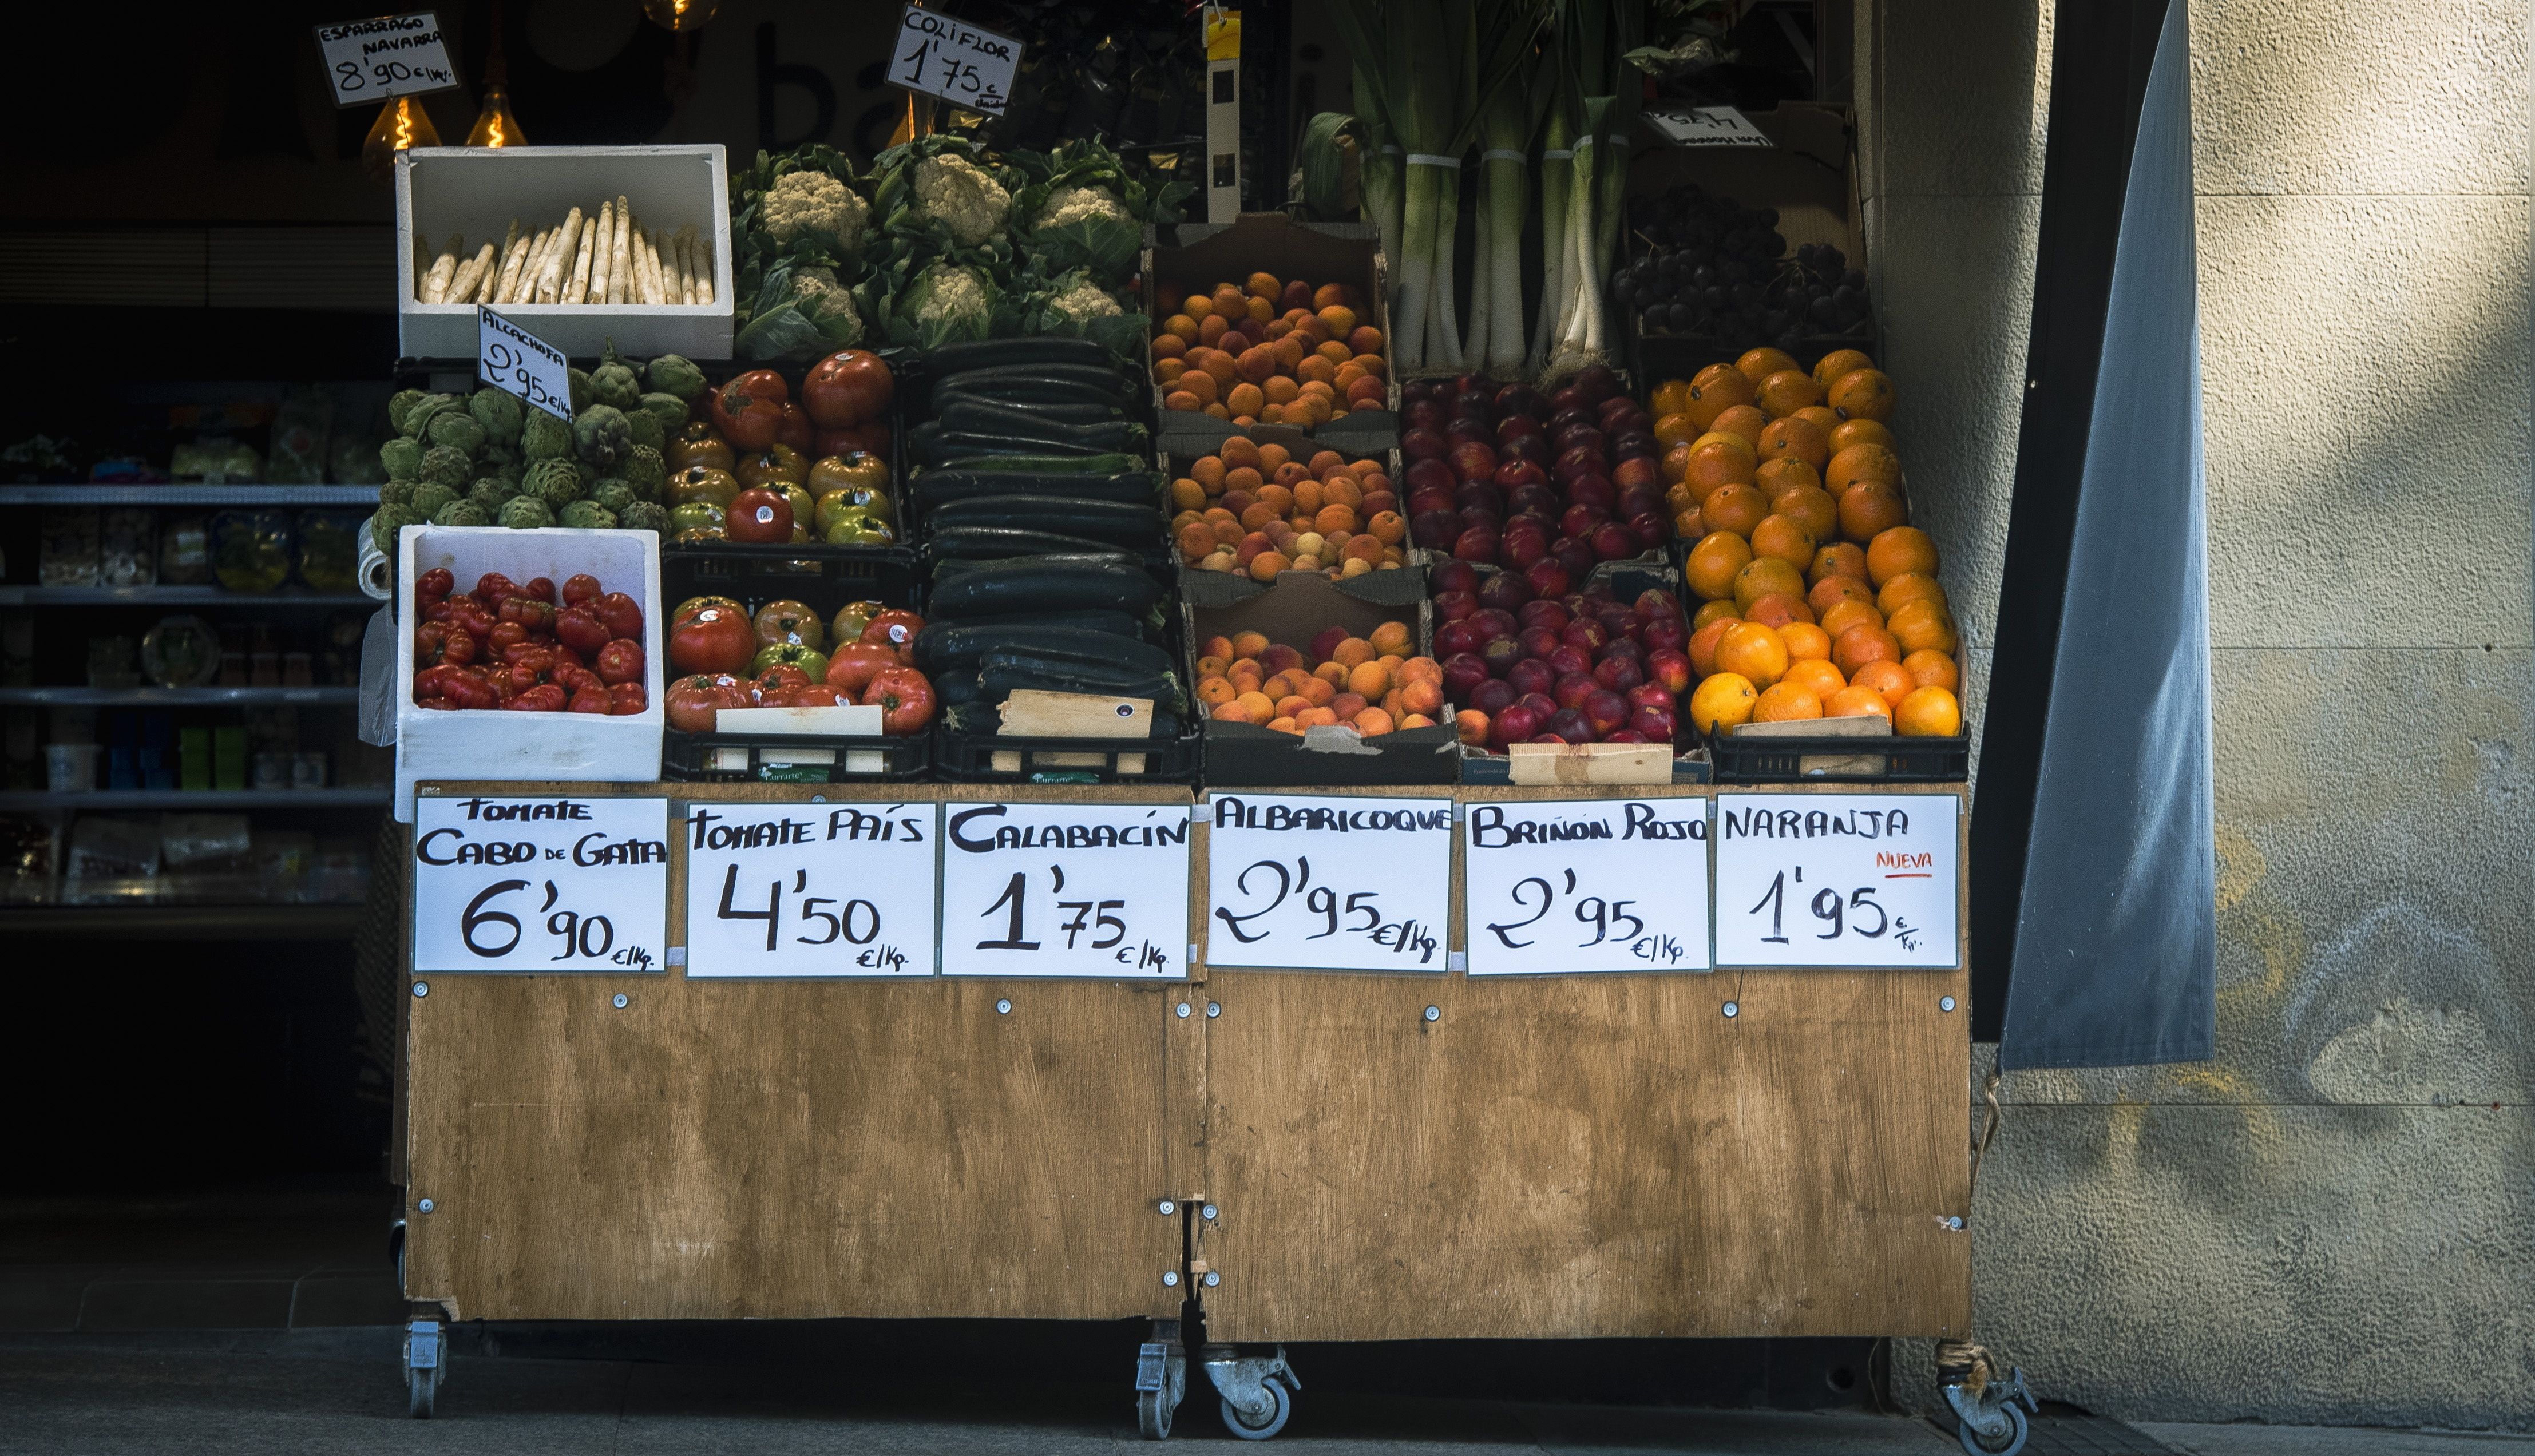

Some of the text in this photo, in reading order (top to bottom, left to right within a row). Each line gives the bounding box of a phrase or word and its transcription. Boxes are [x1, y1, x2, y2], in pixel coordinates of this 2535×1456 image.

[320, 17, 425, 42] ESPARRAGO
[362, 31, 444, 54] NAVARRA
[482, 310, 564, 367] ALCACHOFA
[457, 797, 593, 822] TOMATE
[685, 803, 924, 851] TOMATE PAÍS
[1215, 796, 1452, 833] ALBARICOQUE
[1621, 802, 1708, 840] ROJO
[1725, 806, 1910, 840] NARANJA
[416, 827, 667, 867] CABO DE GATA
[948, 804, 1190, 854] CALABACÍN
[1876, 851, 1933, 870] NUEVA
